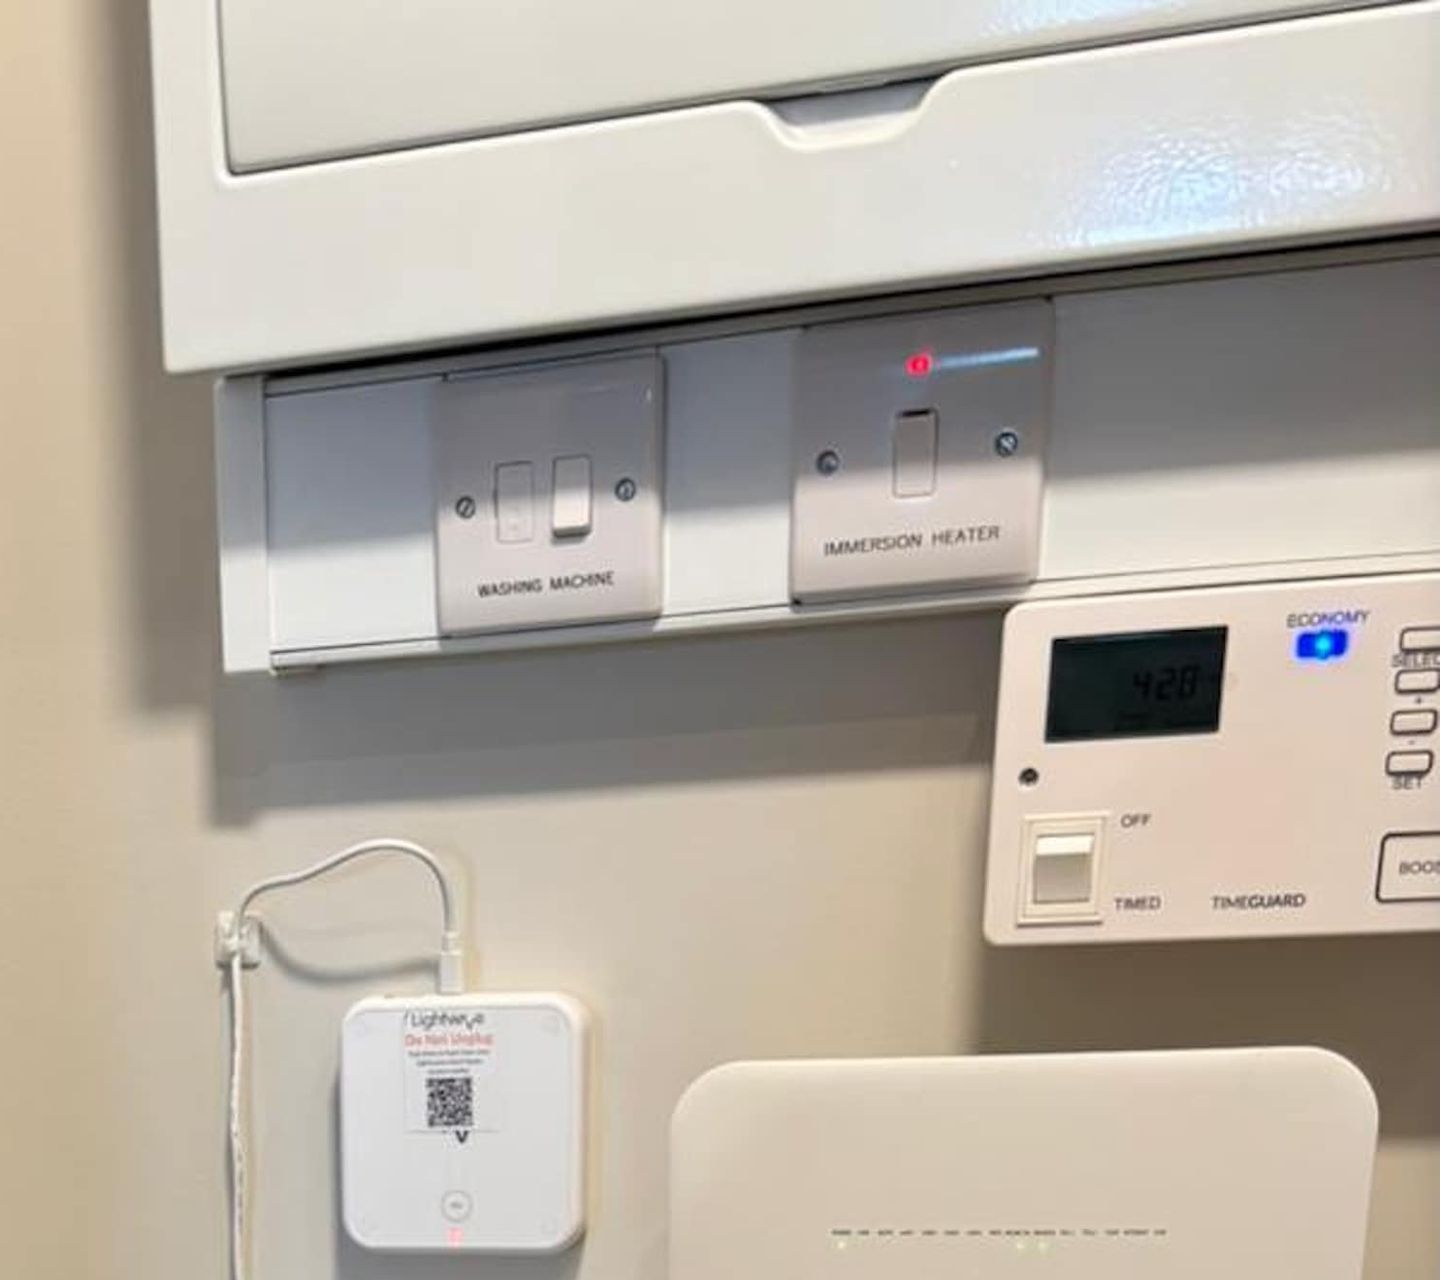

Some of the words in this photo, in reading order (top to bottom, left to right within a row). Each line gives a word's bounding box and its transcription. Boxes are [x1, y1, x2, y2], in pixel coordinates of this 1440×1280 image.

[823, 533, 923, 556] IMMERSION
[931, 525, 1000, 546] HEATER
[477, 578, 543, 598] WASHING
[549, 570, 615, 590] MACHINE
[1286, 610, 1369, 629] ECONOMY
[1120, 813, 1152, 829] OFF
[1114, 896, 1162, 912] TIMED
[1211, 892, 1307, 911] TIMEGUARD
